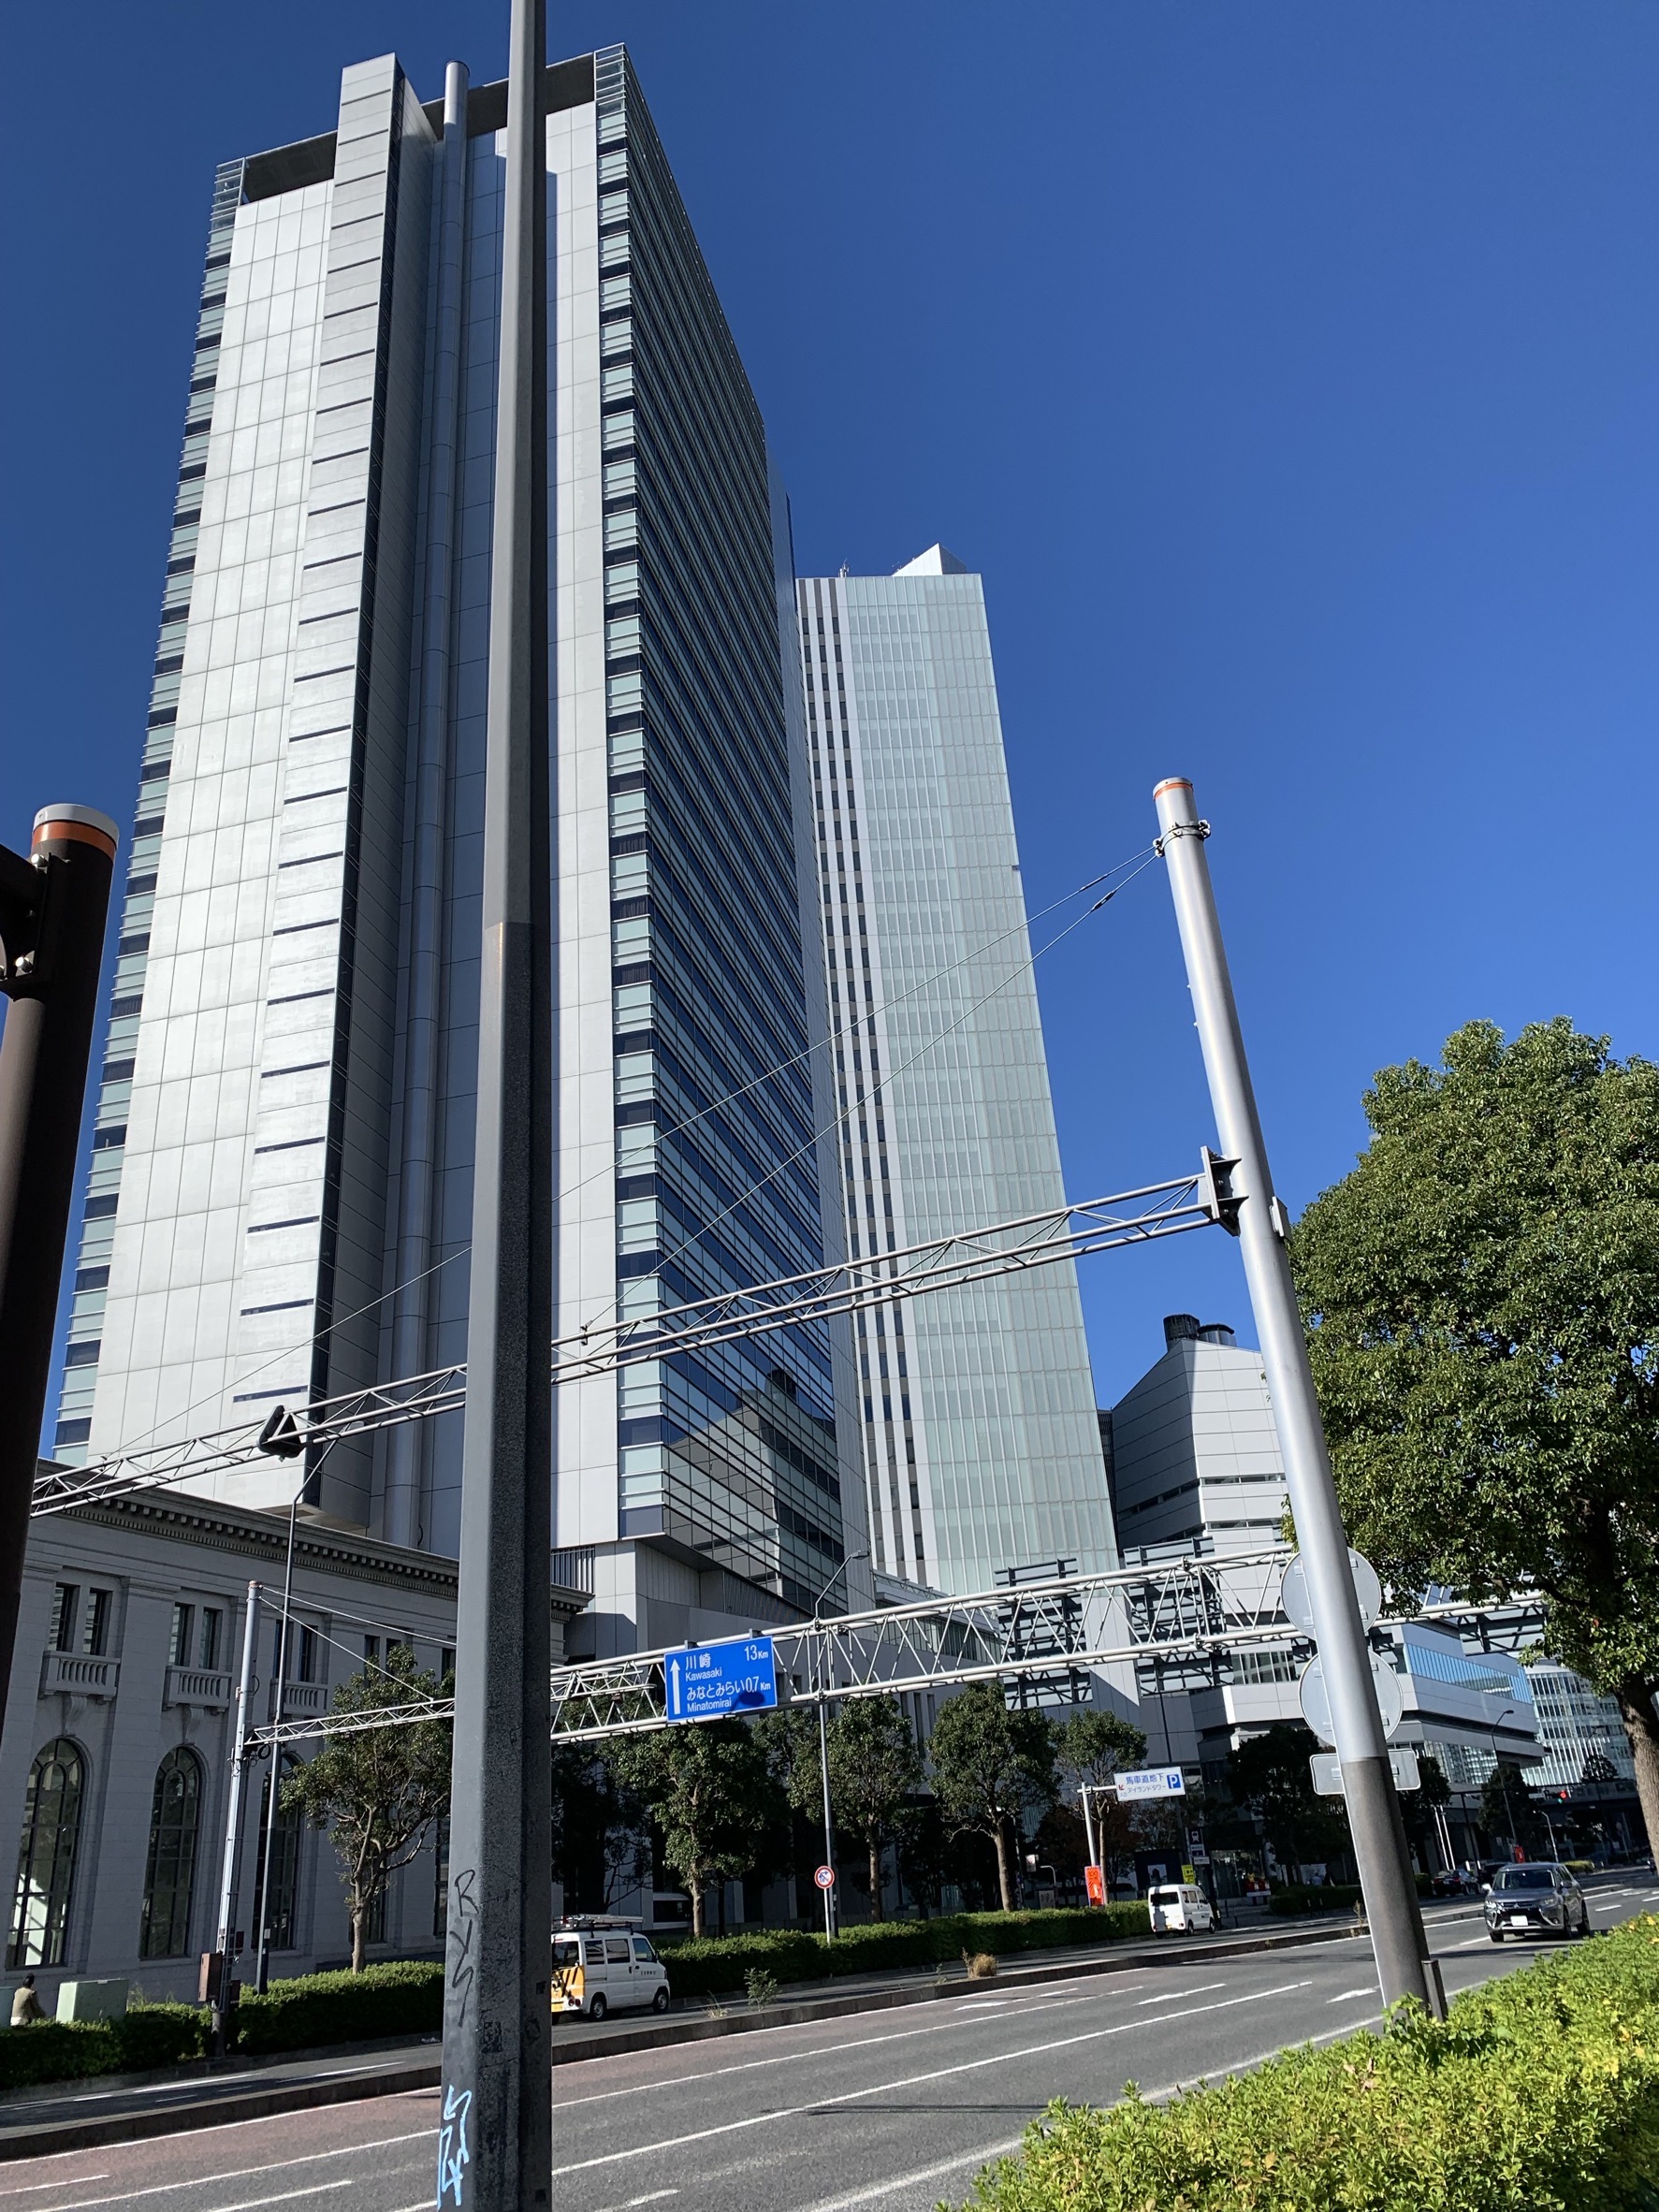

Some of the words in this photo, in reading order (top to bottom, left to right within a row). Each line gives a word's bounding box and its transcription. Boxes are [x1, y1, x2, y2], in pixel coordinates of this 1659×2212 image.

[685, 1652, 711, 1670] 川崎
[744, 1644, 758, 1662] 13
[758, 1651, 769, 1660] Km
[685, 1666, 722, 1681] Kawasaki
[687, 1680, 745, 1701] みなとみらい
[746, 1675, 760, 1693] 0.7
[760, 1681, 771, 1691] Km
[687, 1697, 732, 1713] Minatomirai
[1126, 1772, 1164, 1784] 馬車道地下
[1169, 1775, 1178, 1788] P
[1128, 1784, 1166, 1793] アイランドタワー
